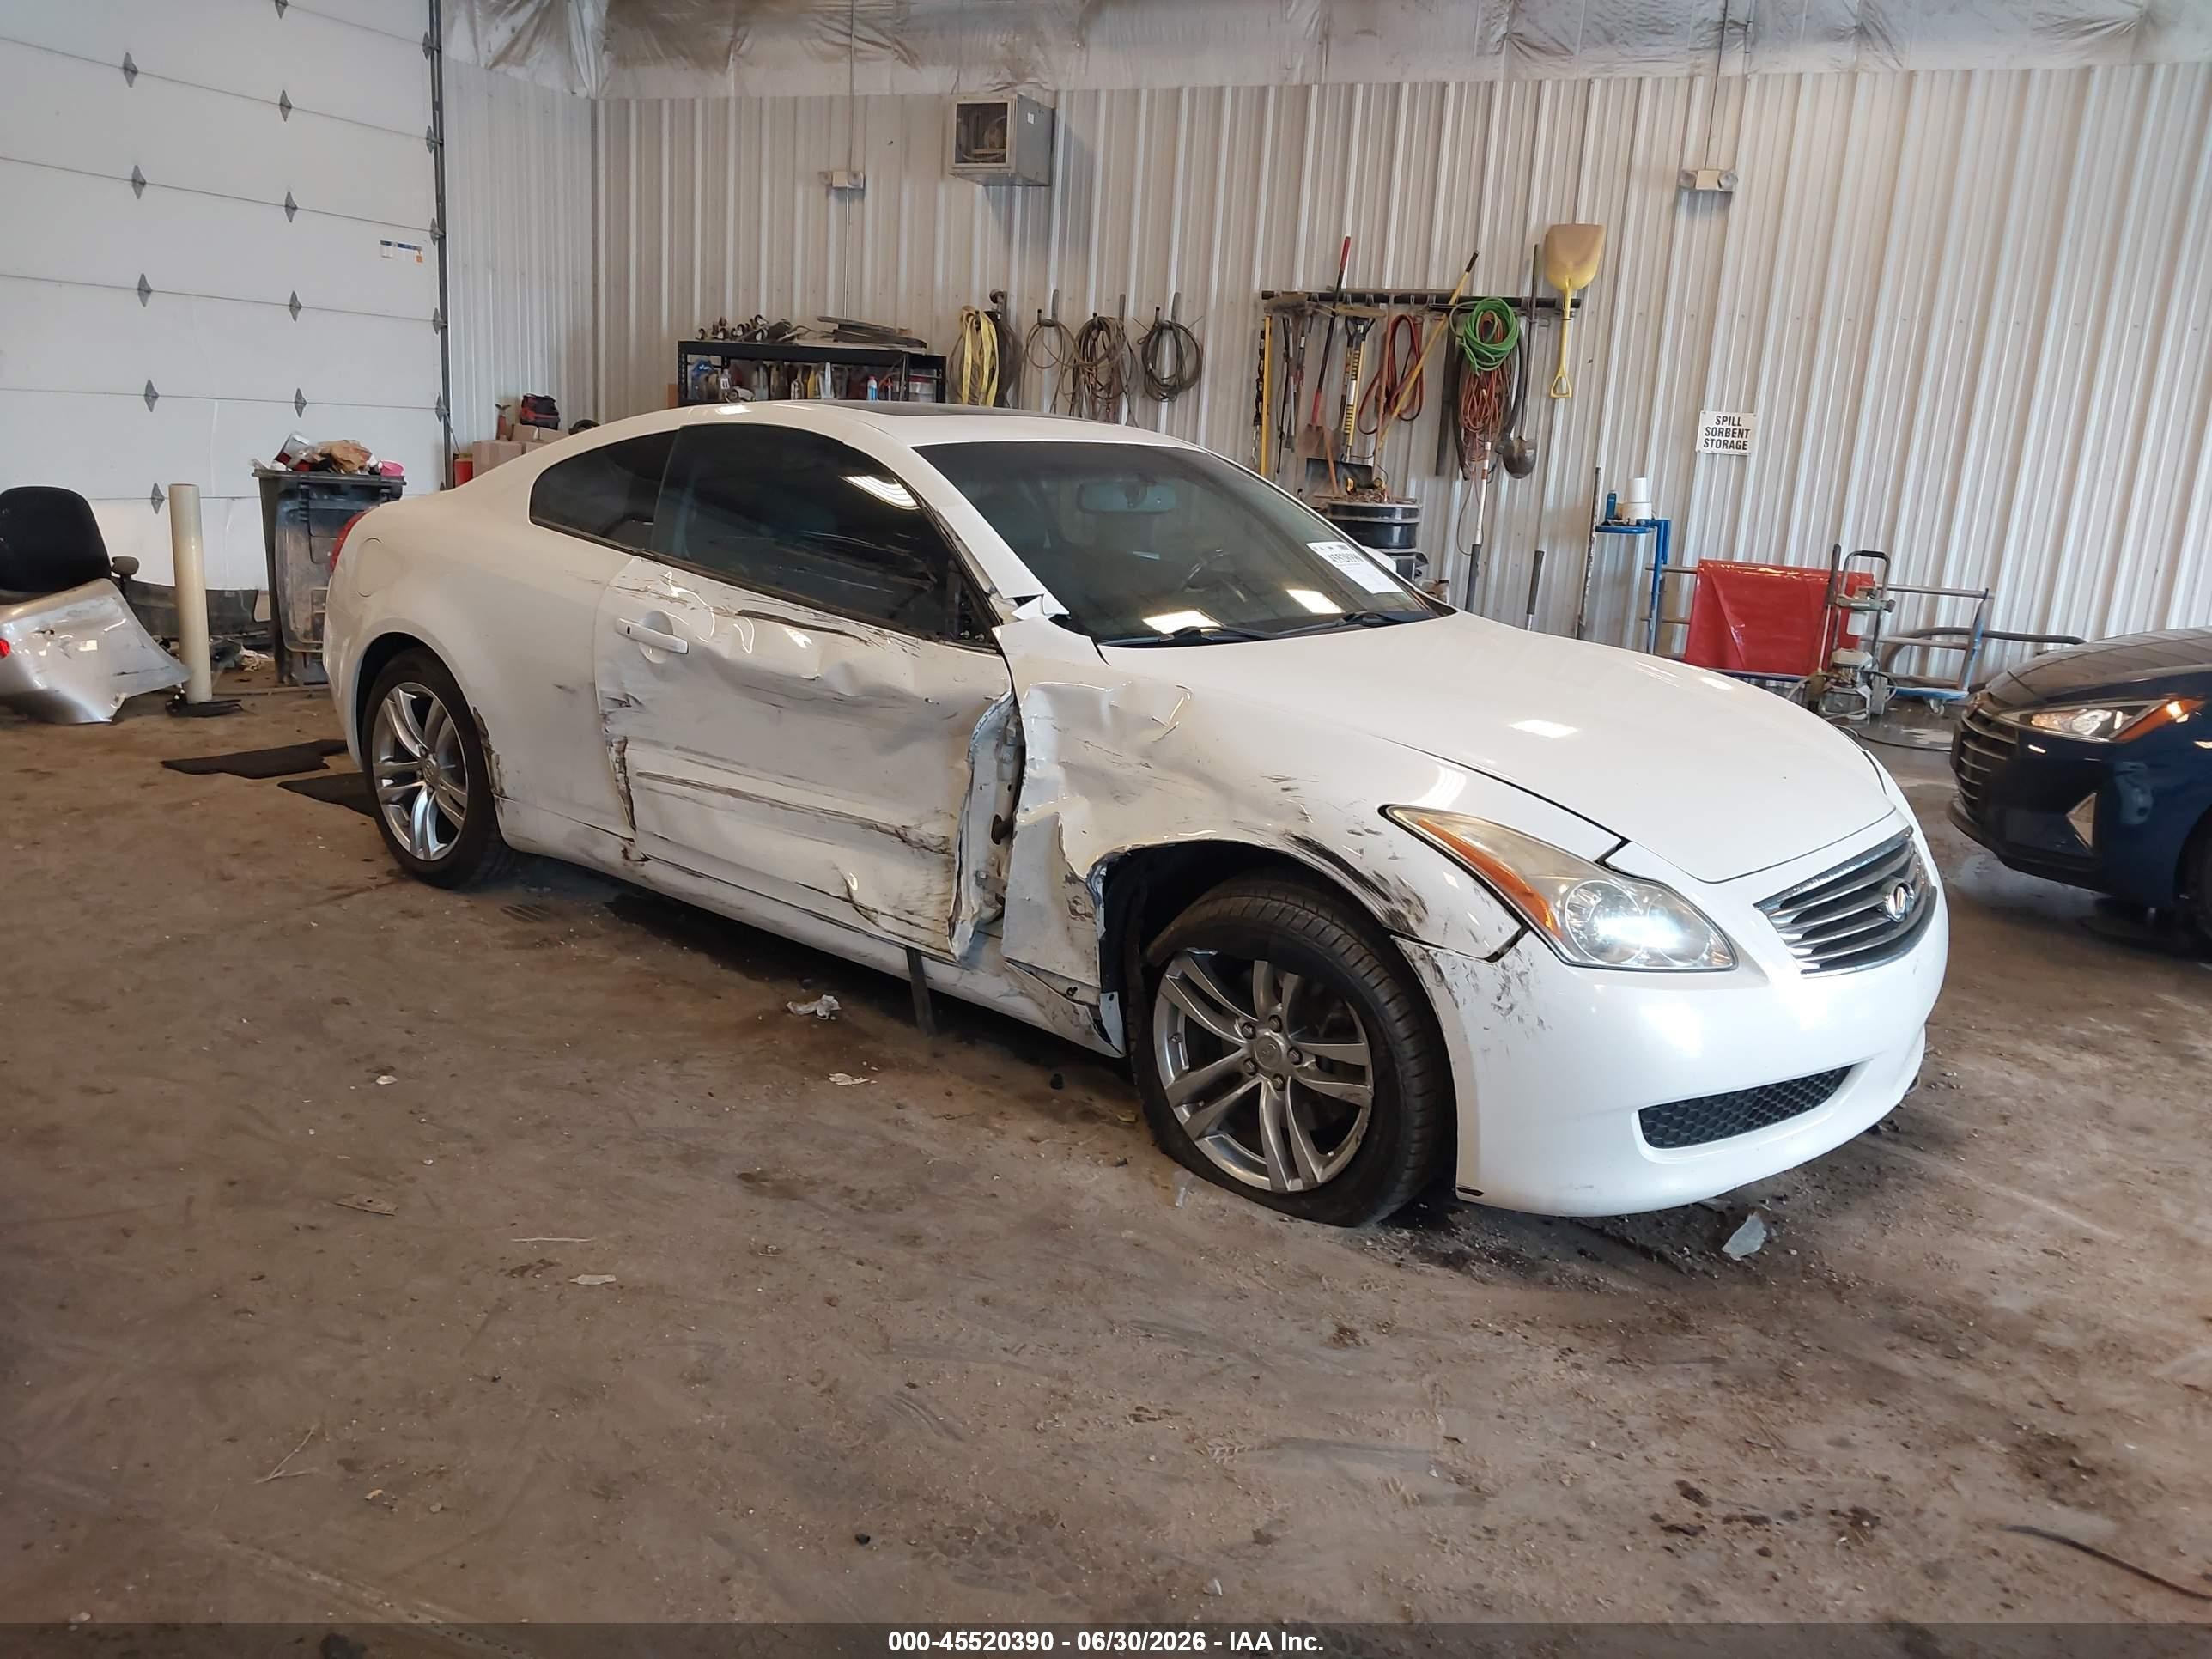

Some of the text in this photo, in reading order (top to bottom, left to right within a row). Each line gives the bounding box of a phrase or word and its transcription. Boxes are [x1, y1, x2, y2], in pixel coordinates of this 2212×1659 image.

[1715, 416, 1742, 427] SPILL
[1705, 427, 1751, 439] SORBENT
[1703, 438, 1748, 451] STORAGE
